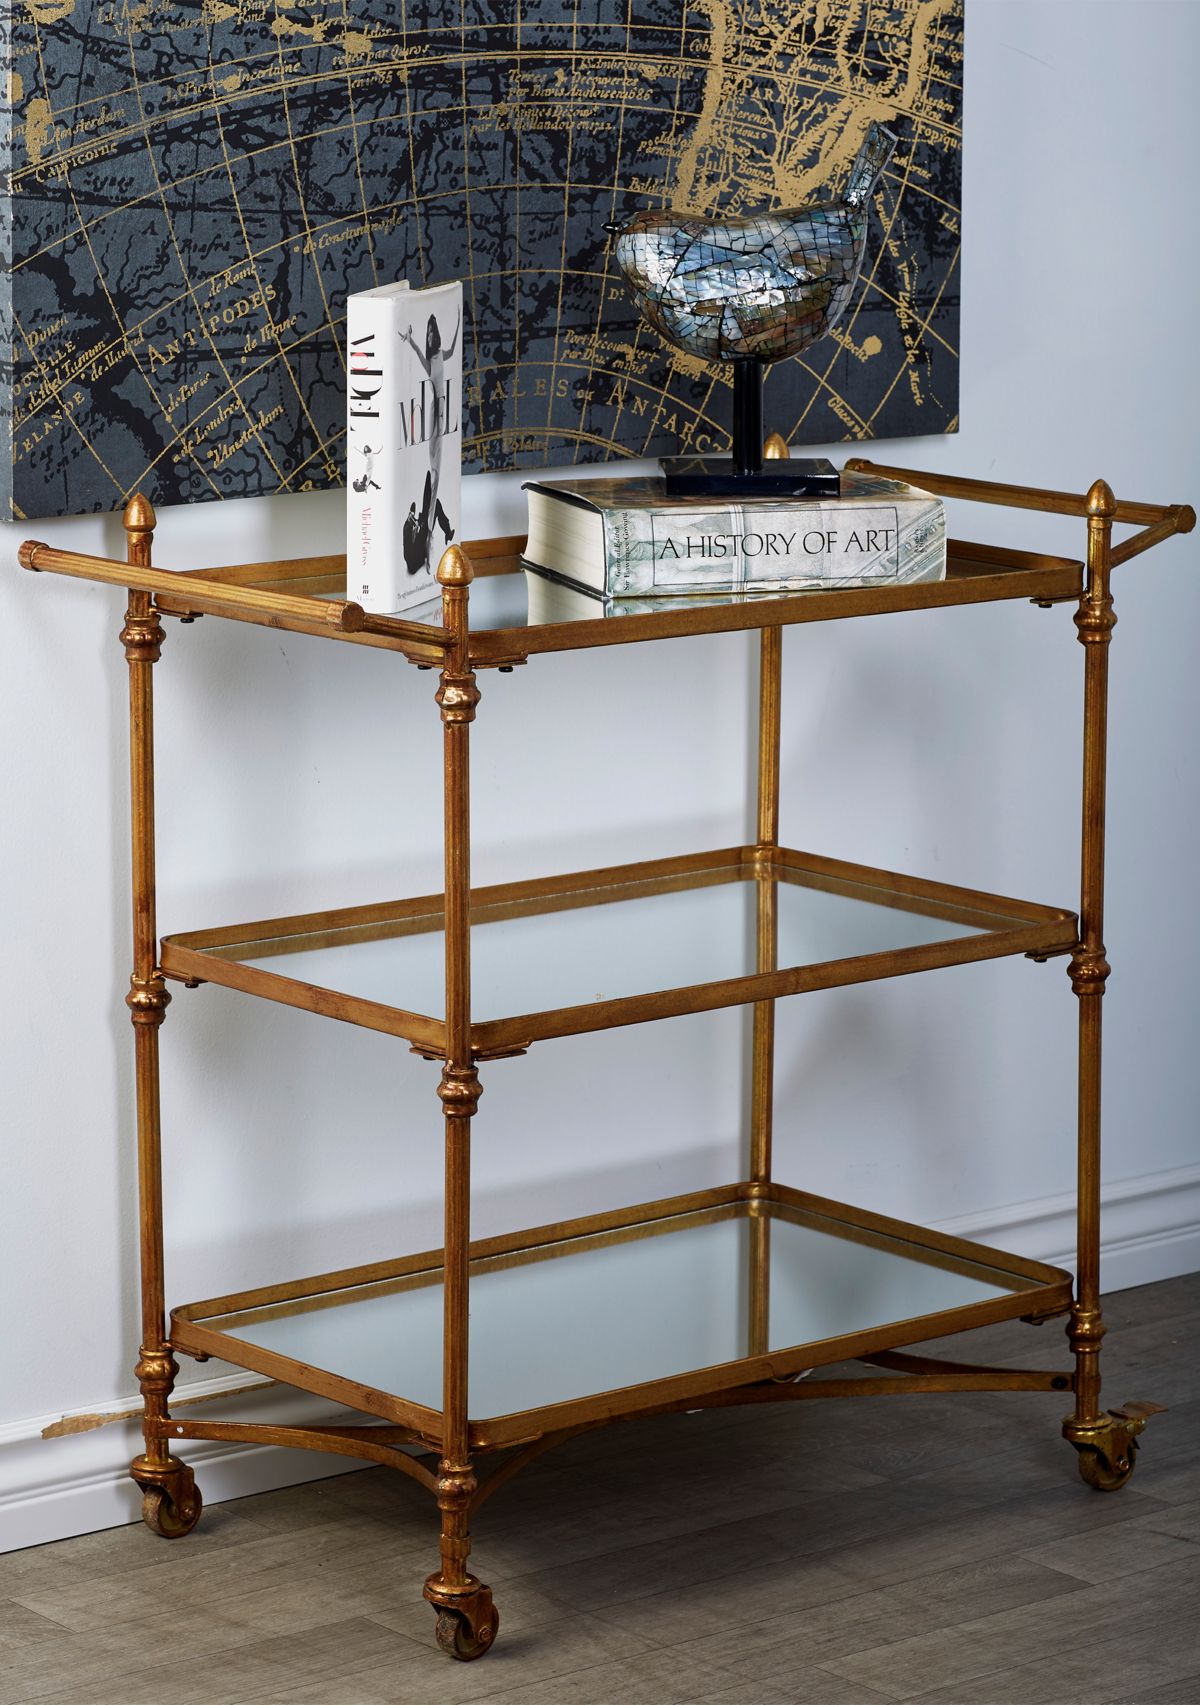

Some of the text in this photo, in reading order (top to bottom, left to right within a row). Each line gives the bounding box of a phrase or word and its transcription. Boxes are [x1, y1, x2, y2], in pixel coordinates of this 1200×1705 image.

[350, 334, 383, 432] MODEL
[397, 377, 459, 451] MODEL
[659, 538, 680, 560] A
[687, 532, 796, 559] HISTORY
[803, 531, 838, 555] OF
[844, 529, 896, 553] ART
